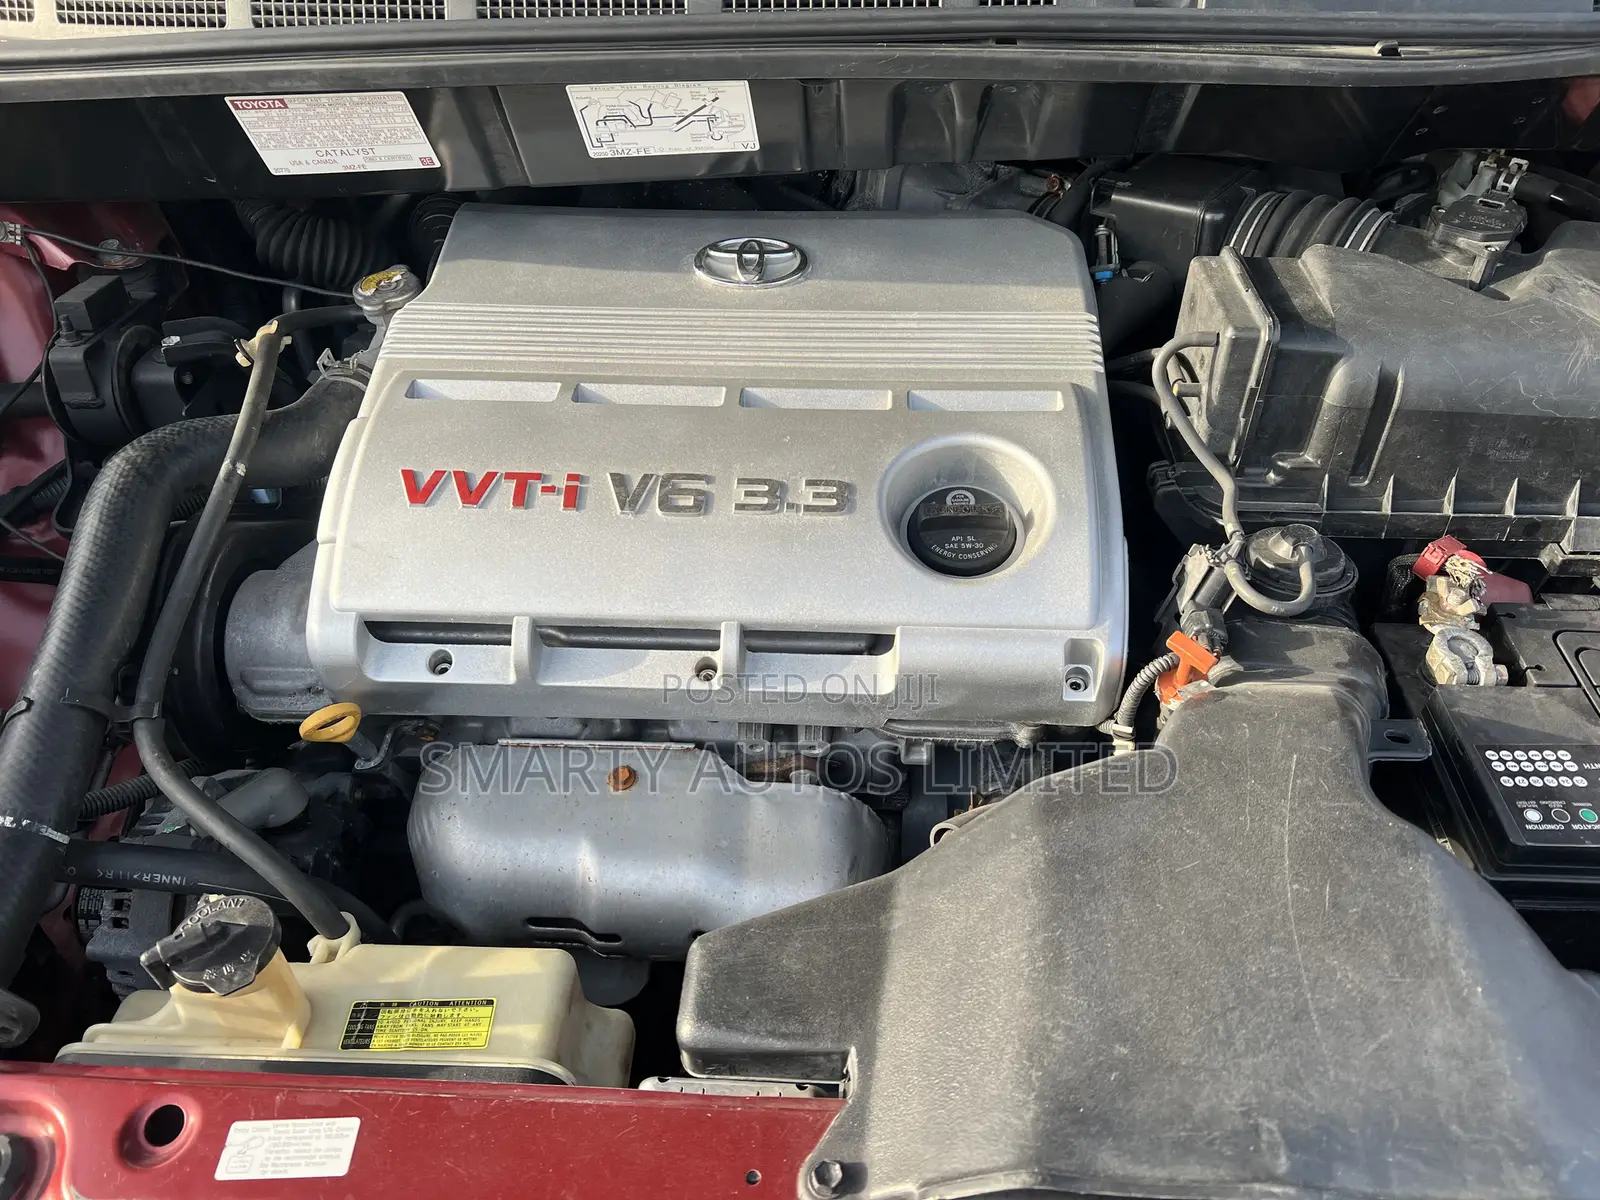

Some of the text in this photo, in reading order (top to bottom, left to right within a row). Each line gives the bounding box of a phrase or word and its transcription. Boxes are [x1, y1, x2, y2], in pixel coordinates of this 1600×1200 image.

[234, 100, 284, 109] TOYOTA
[315, 148, 376, 158] CATALYST
[609, 148, 651, 156] 3MZ-FE
[421, 157, 434, 165] 3E
[400, 468, 850, 516] VVT-i V6 3.3
[931, 543, 998, 560] ENERGY CONSERVING
[180, 898, 247, 938] COOLANT
